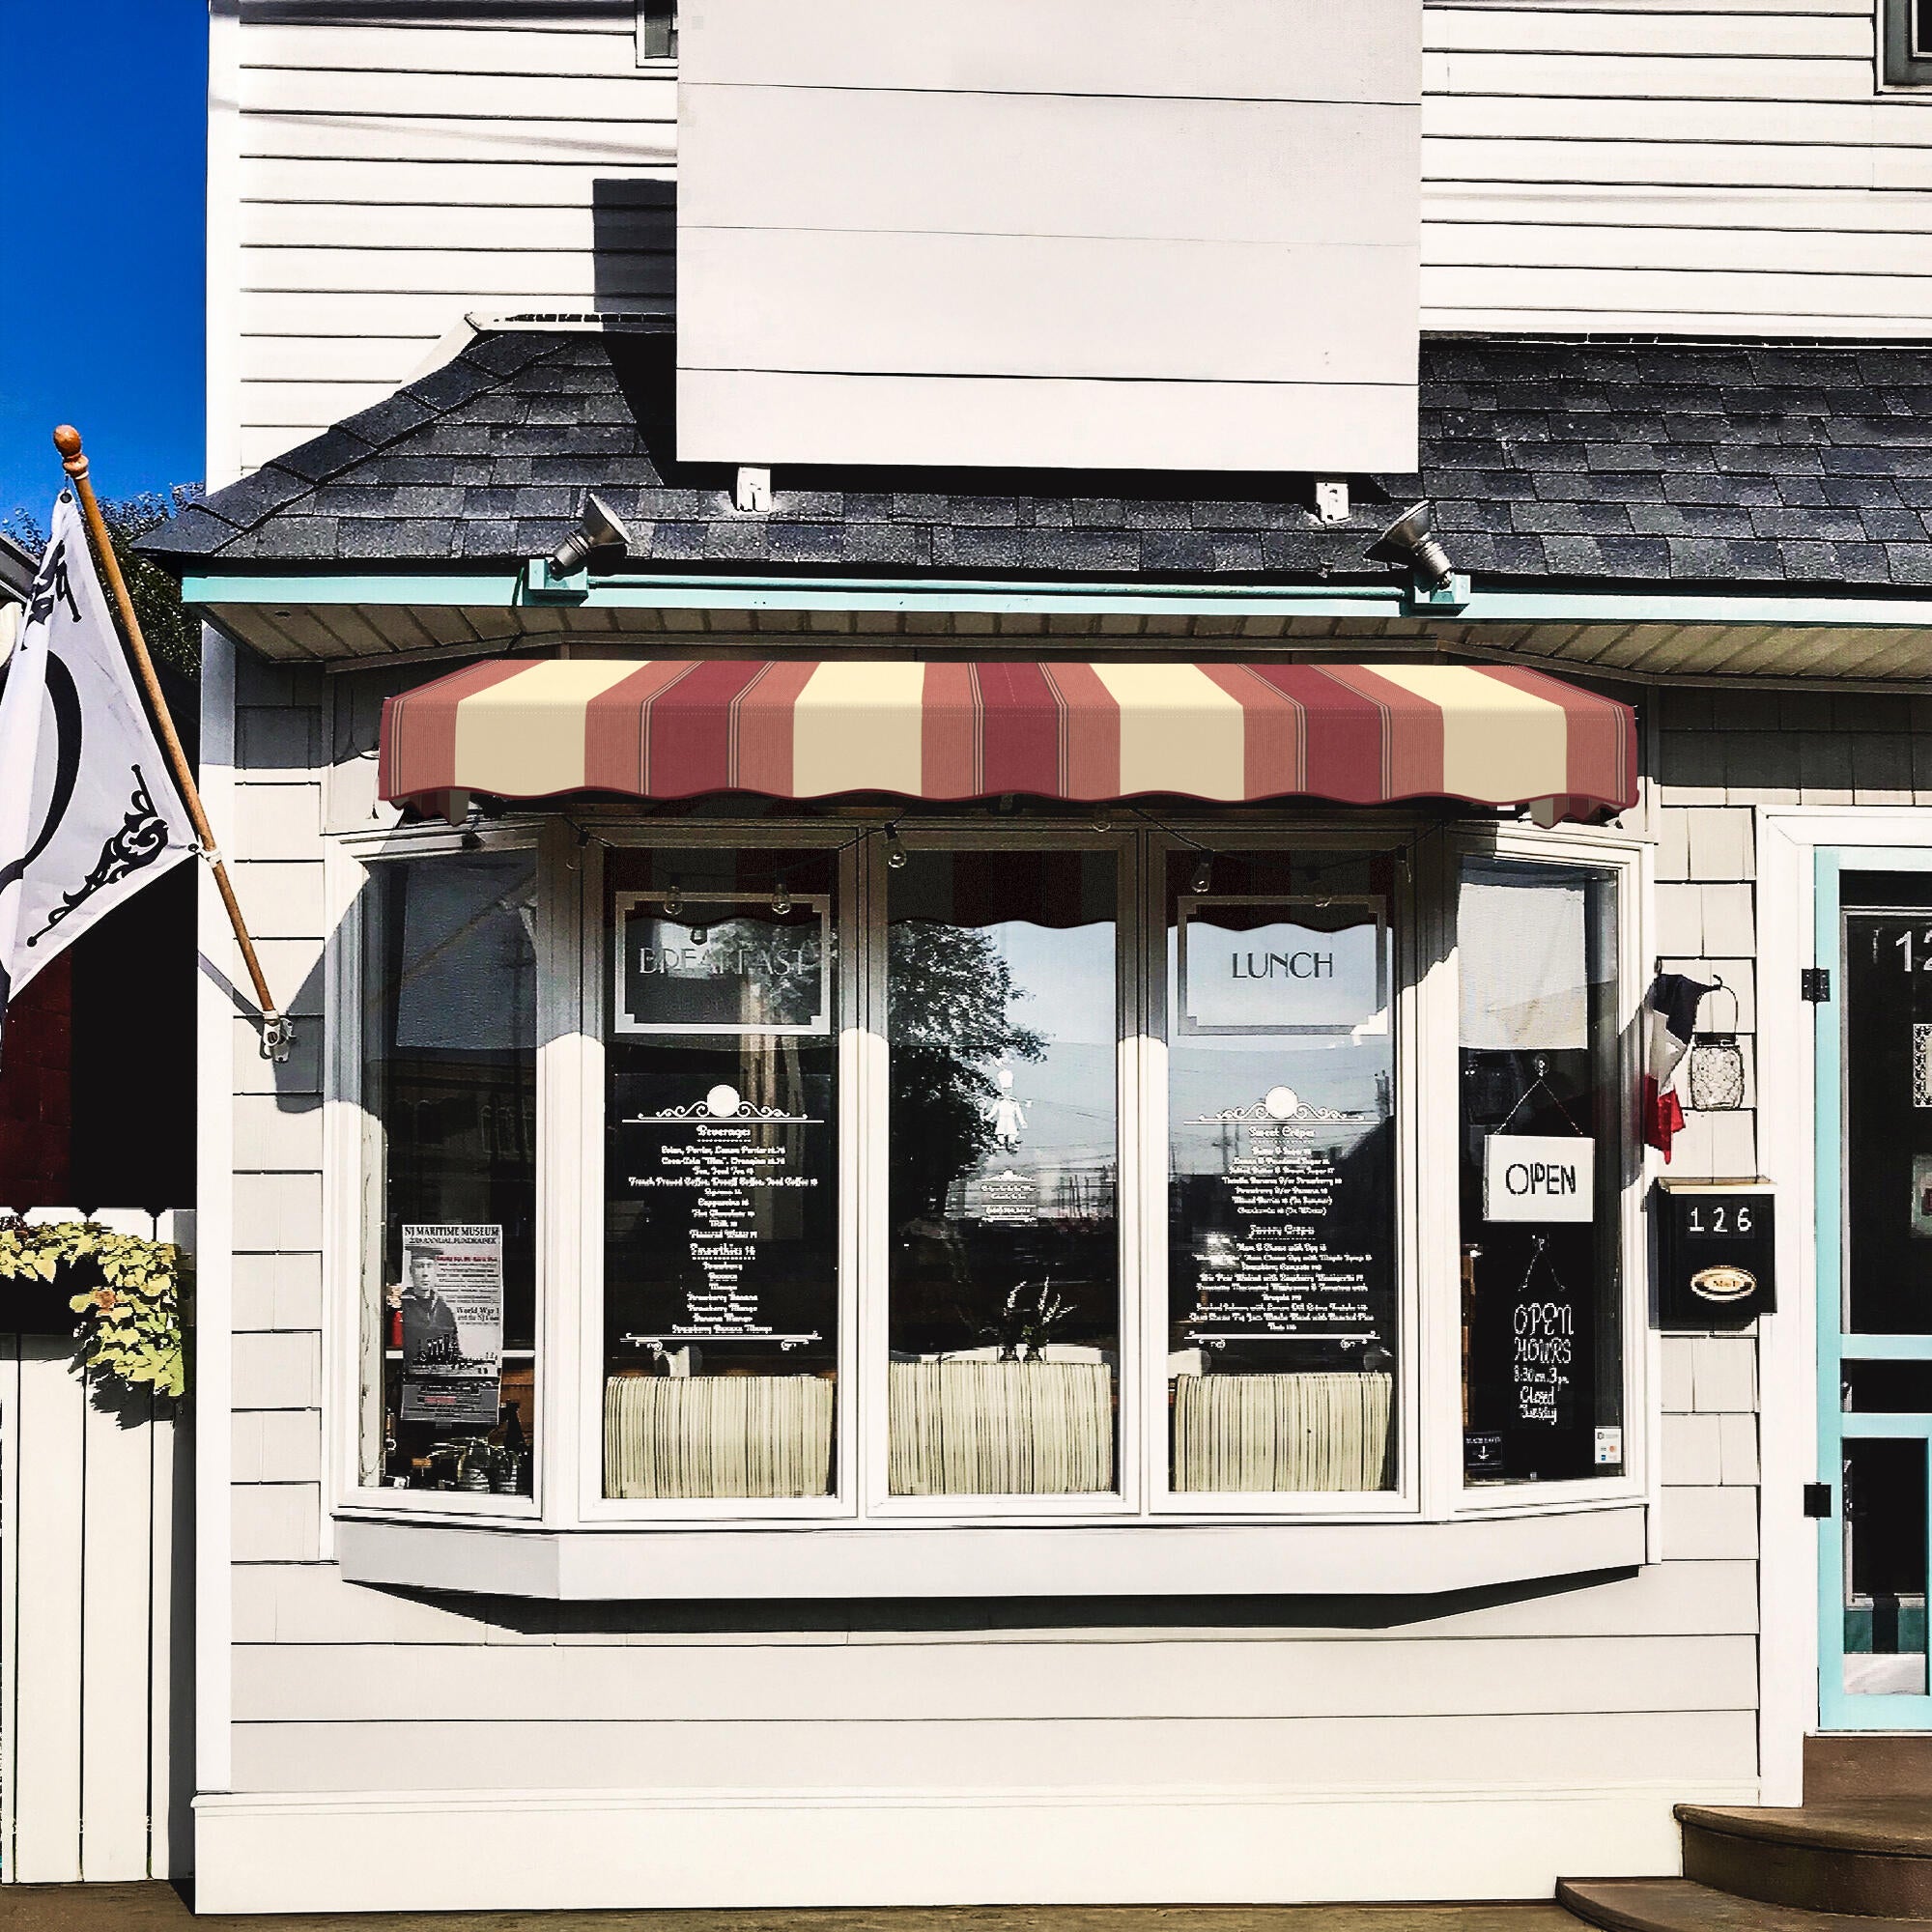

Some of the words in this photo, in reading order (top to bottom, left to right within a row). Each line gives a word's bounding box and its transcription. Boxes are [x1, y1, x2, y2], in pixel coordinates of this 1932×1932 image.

[1232, 952, 1333, 979] LUNCH
[1505, 1162, 1577, 1195] OPEN
[416, 1227, 460, 1236] MARITIME
[461, 1227, 499, 1236] MUSEUM
[1690, 1207, 1752, 1232] 126
[1514, 1302, 1575, 1336] OPEN
